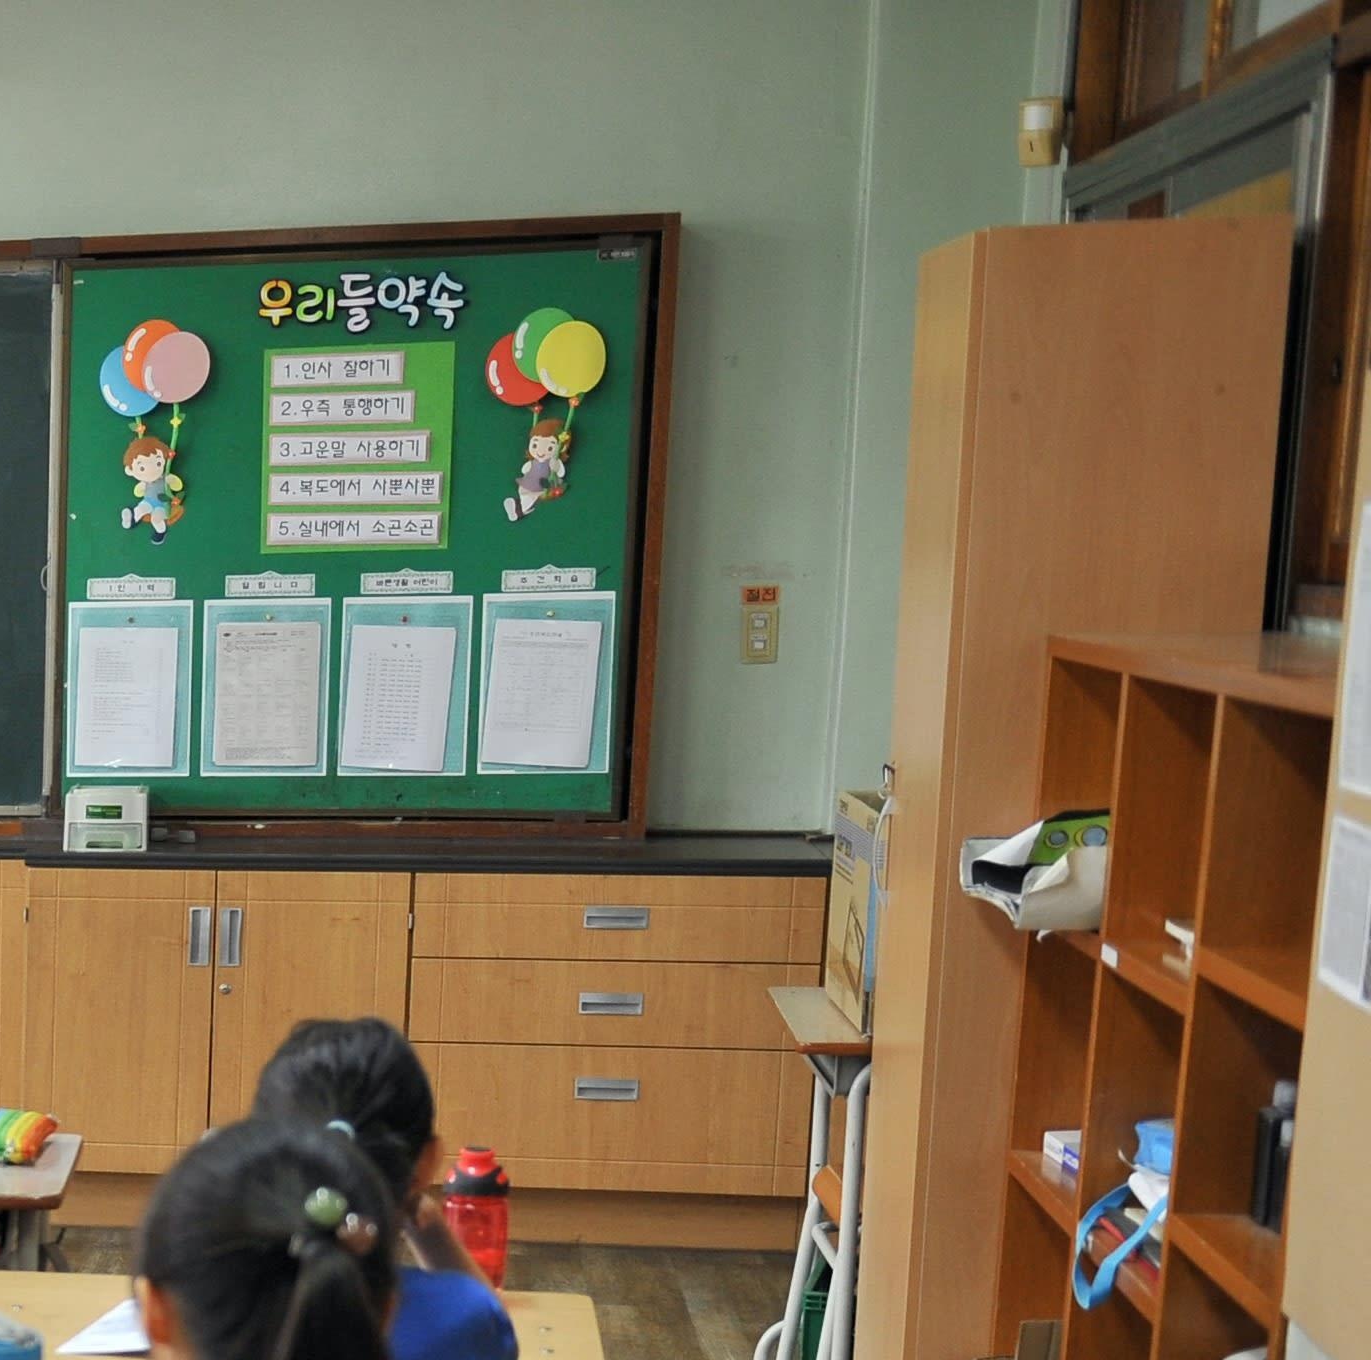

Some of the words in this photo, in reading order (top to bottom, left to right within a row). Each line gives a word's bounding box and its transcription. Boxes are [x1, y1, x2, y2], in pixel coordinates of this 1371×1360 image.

[343, 359, 390, 378] 잘하기
[342, 396, 405, 416] 통행하기
[356, 439, 420, 458] 사용하기
[372, 477, 436, 496] 사뿐사뿐
[372, 518, 435, 537] 소곤소곤
